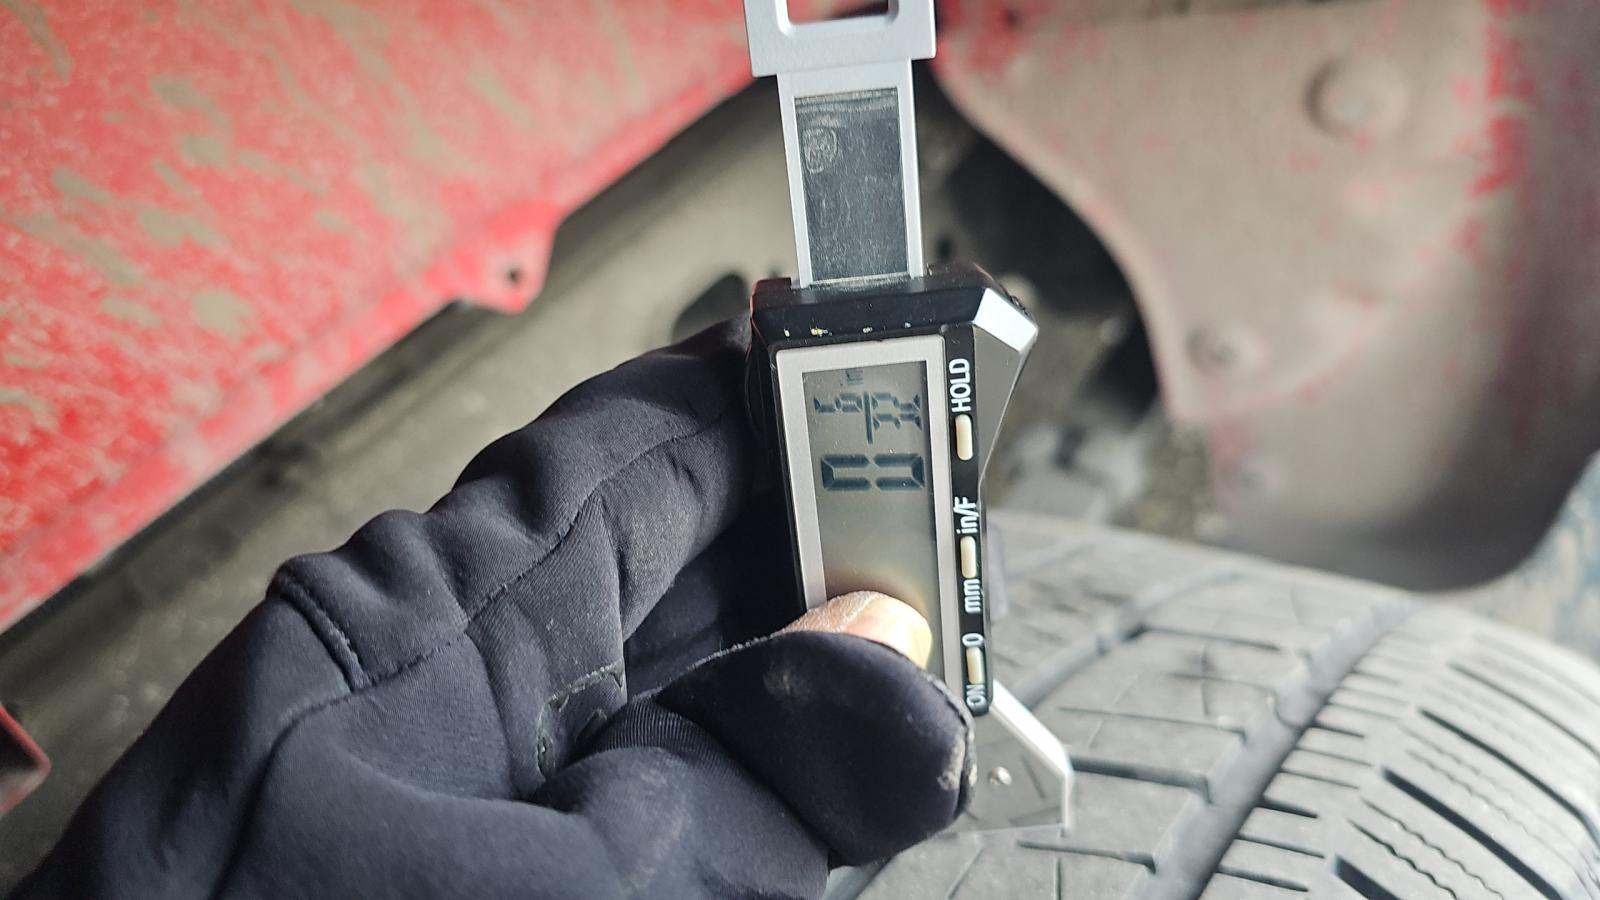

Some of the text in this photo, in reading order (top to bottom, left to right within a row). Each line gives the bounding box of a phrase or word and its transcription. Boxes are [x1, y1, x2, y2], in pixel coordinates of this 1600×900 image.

[949, 358, 971, 413] HOLD
[821, 454, 925, 491] 0
[953, 496, 980, 534] in/F
[964, 578, 982, 614] mm
[966, 684, 987, 710] ON
